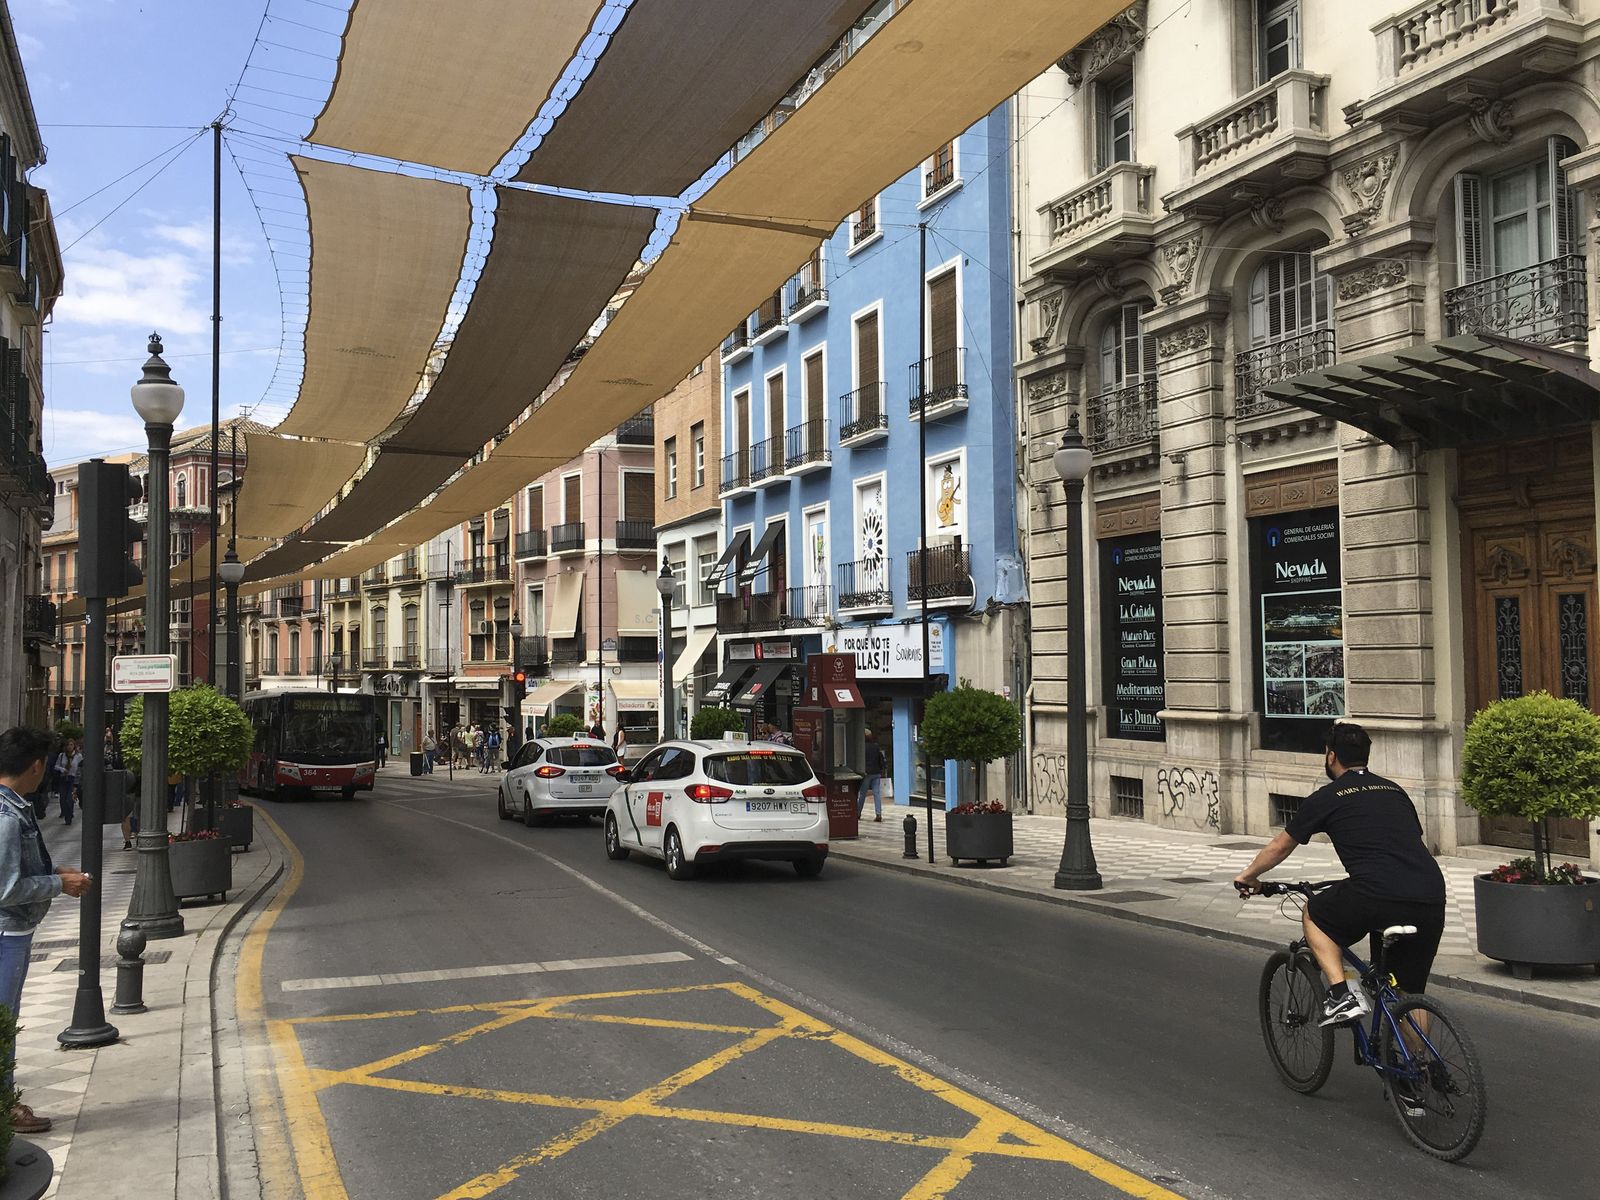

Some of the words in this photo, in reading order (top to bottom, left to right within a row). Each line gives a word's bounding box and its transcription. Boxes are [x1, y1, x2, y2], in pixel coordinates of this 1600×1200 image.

[1283, 527, 1305, 536] GENERAL
[1311, 522, 1335, 532] GALERIAS
[1283, 534, 1317, 544] COMERCIALES
[844, 638, 856, 650] POR
[856, 633, 869, 650] QUÉ
[870, 637, 881, 650] NO
[882, 637, 890, 649] TE
[857, 651, 880, 671] LLAS
[1116, 683, 1163, 695] Mediterraneo
[1336, 786, 1360, 797] WARN
[751, 802, 770, 811] 9207
[792, 803, 806, 812] SP
